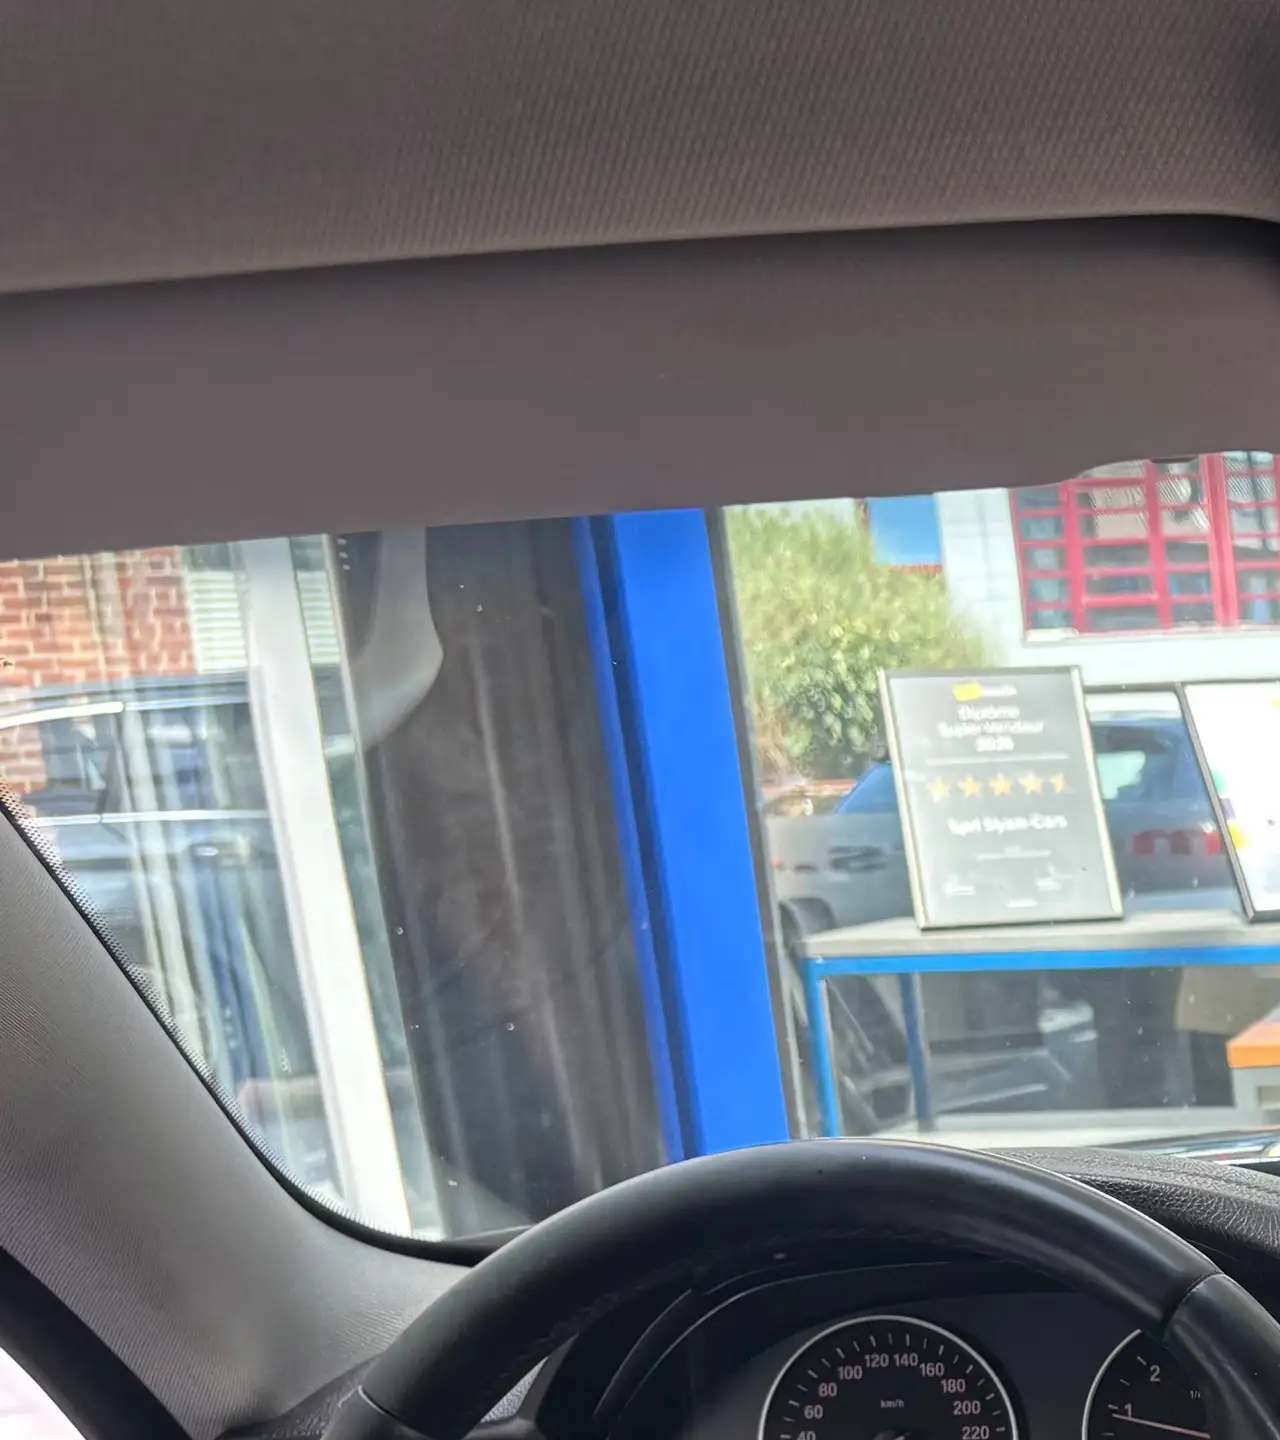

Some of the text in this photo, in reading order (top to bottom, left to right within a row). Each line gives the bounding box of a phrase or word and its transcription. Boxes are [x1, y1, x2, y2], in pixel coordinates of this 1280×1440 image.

[864, 1353, 890, 1368] 120
[893, 1353, 918, 1368] 140
[837, 1366, 863, 1380] 100
[919, 1362, 945, 1377] 160
[1150, 1364, 1161, 1382] 2
[818, 1383, 838, 1397] 80
[940, 1379, 966, 1393] 180
[880, 1399, 905, 1409] km/h
[953, 1401, 981, 1415] 200
[1124, 1403, 1134, 1417] 1
[804, 1405, 824, 1419] 60
[962, 1426, 990, 1440] 220
